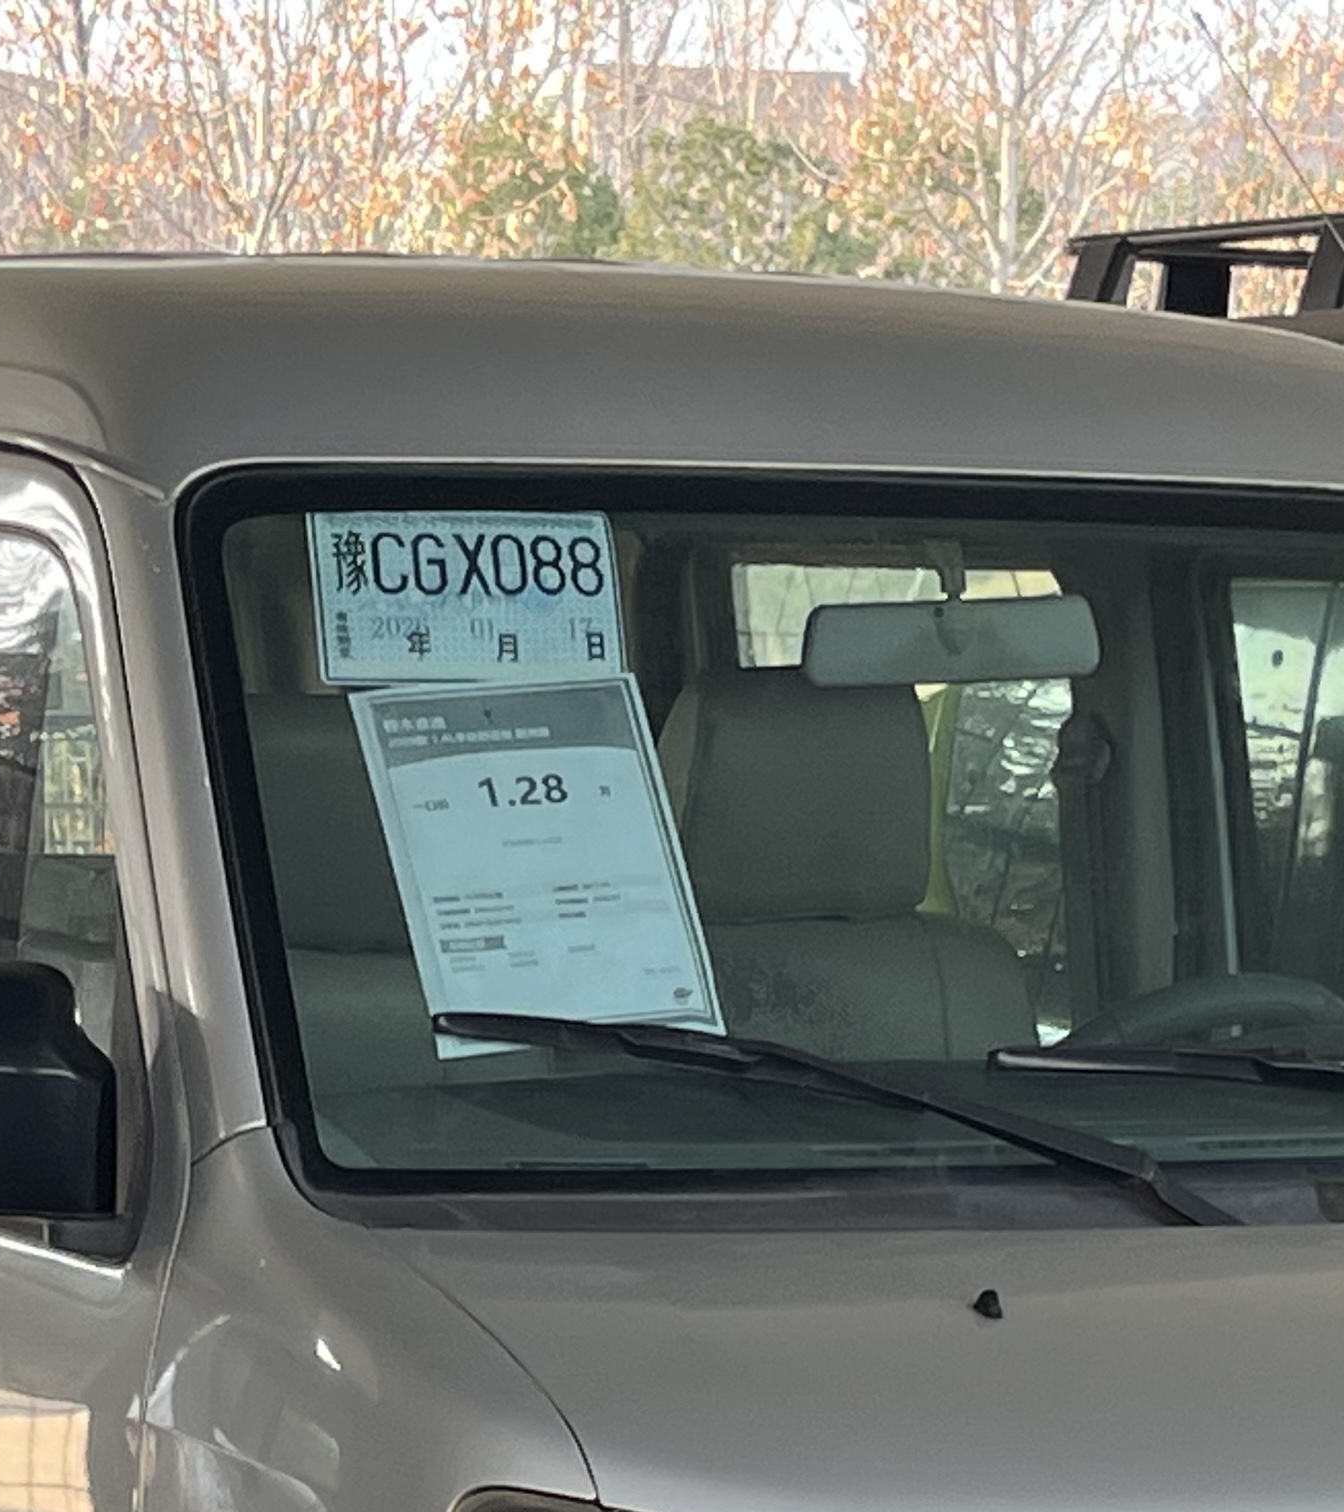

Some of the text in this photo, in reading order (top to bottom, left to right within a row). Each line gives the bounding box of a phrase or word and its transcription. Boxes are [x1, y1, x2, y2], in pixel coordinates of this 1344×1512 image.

[330, 531, 605, 596] 豫CGX088
[407, 626, 432, 660] 年
[497, 633, 518, 662] 月
[586, 631, 606, 661] 日
[478, 773, 568, 807] 1.28
